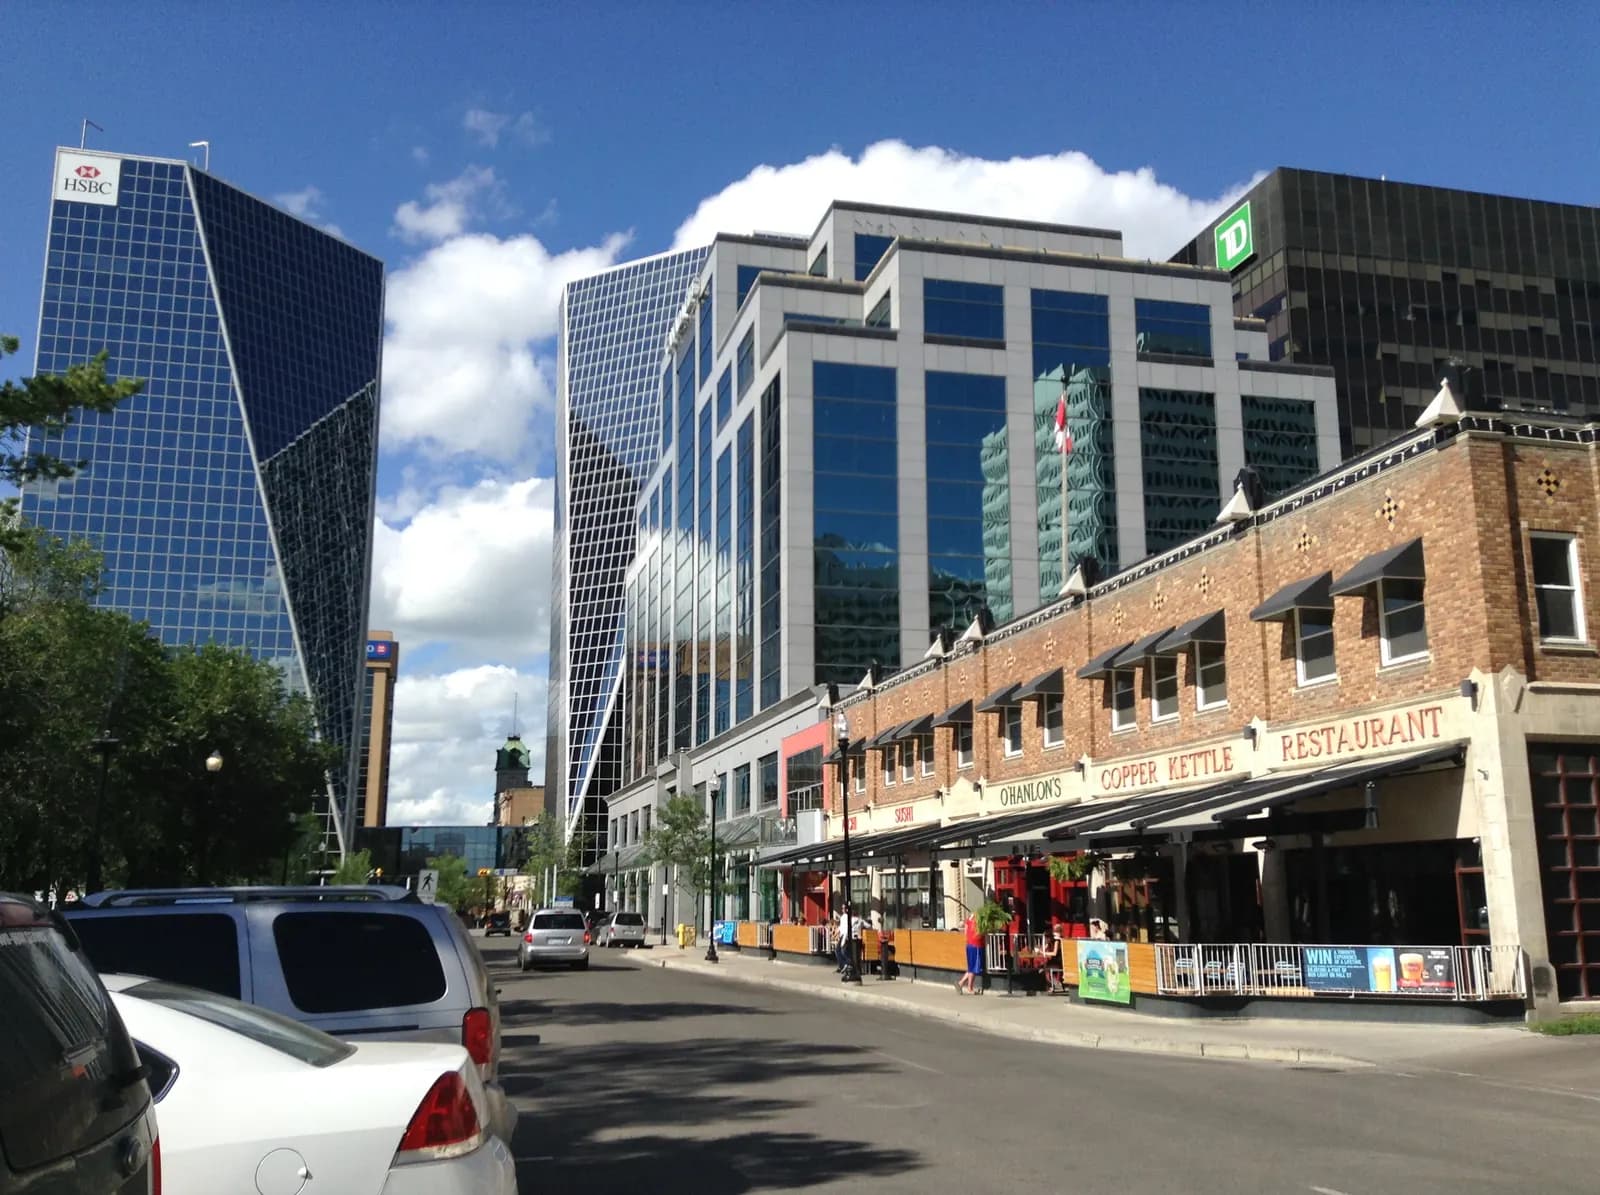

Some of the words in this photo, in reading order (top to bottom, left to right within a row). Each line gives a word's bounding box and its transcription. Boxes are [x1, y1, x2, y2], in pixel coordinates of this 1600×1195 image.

[64, 178, 112, 195] HSBC
[1219, 218, 1248, 261] TD
[1281, 706, 1443, 762] RESTAURANT
[1101, 761, 1158, 790] COPPER
[1168, 746, 1233, 781] KETTLE
[1000, 777, 1062, 806] O'HANLON'S
[895, 806, 914, 823] SUSHI
[1306, 949, 1333, 965] WIN
